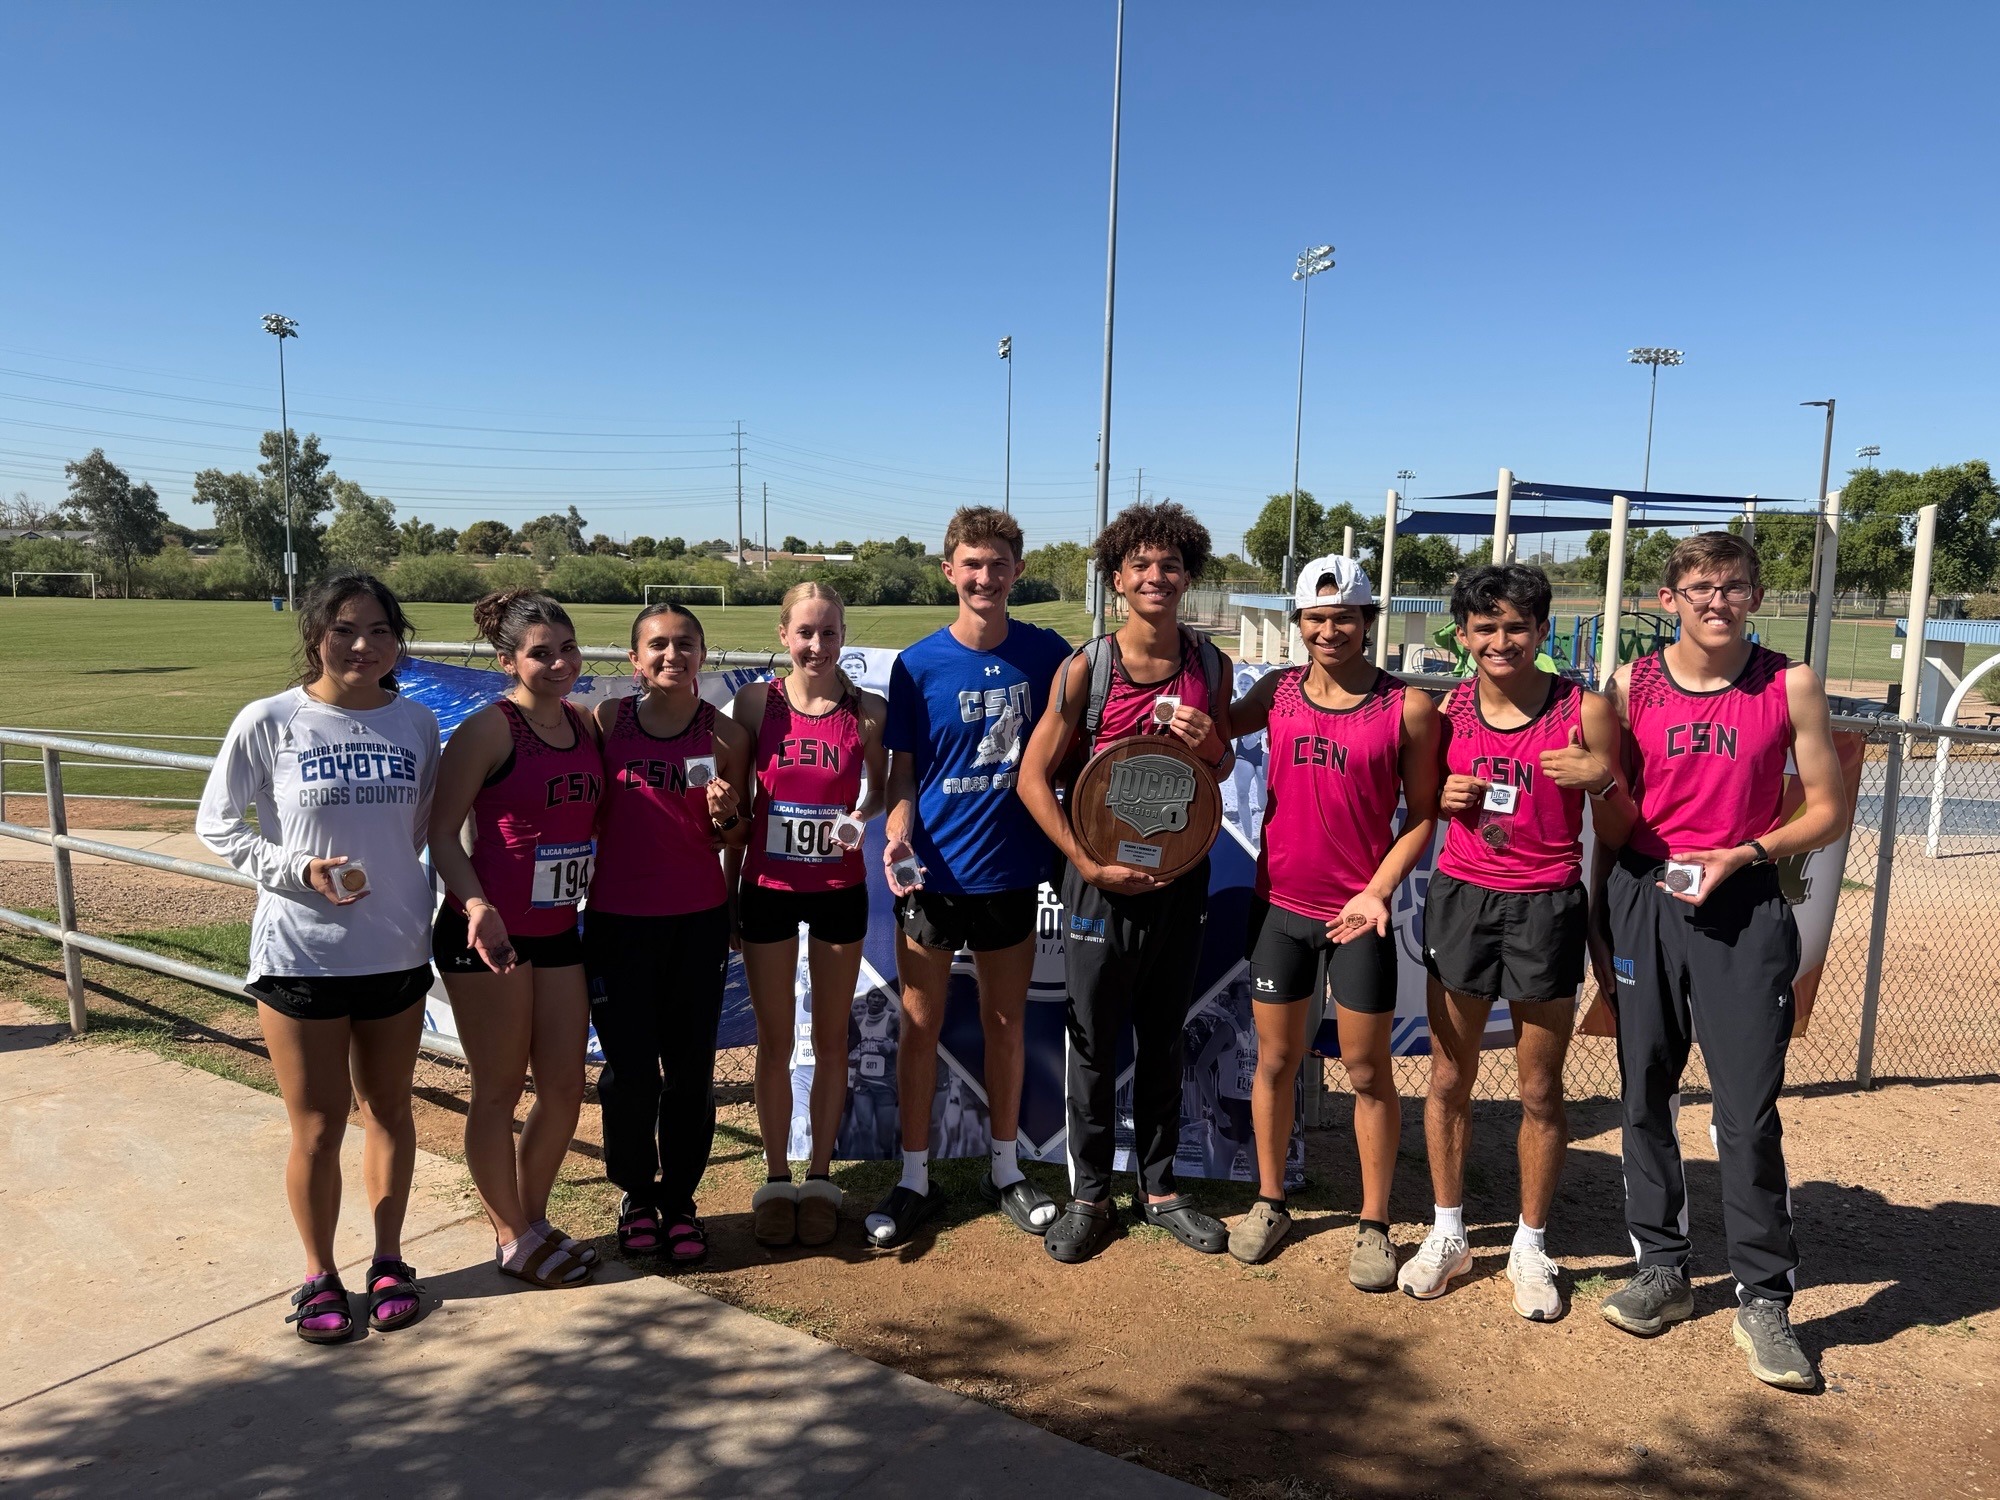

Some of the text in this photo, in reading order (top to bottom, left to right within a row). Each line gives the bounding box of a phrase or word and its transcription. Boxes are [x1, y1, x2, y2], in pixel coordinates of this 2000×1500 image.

[959, 681, 1031, 723] CSN
[298, 742, 417, 763] COLLEGE OF SOUTHERN NEVADA
[777, 738, 840, 774] CSN
[1293, 735, 1349, 777] CSN
[1666, 722, 1738, 761] CSN
[301, 753, 416, 785] COYOTES
[625, 759, 687, 798] CSN
[943, 775, 990, 794] CROSS
[1107, 766, 1192, 802] NJCAA
[1472, 756, 1534, 796] CSN
[300, 785, 418, 808] CROSS COUNTRY
[545, 772, 602, 810] CSN
[773, 805, 794, 814] NJCAA
[795, 807, 817, 816] Region
[1123, 805, 1177, 825] REGION 1
[540, 848, 562, 857] NJCAA
[782, 819, 834, 855] 190
[550, 857, 590, 900] 194
[1070, 932, 1106, 944] CROSS COUNTRY
[1071, 914, 1106, 938] CSN
